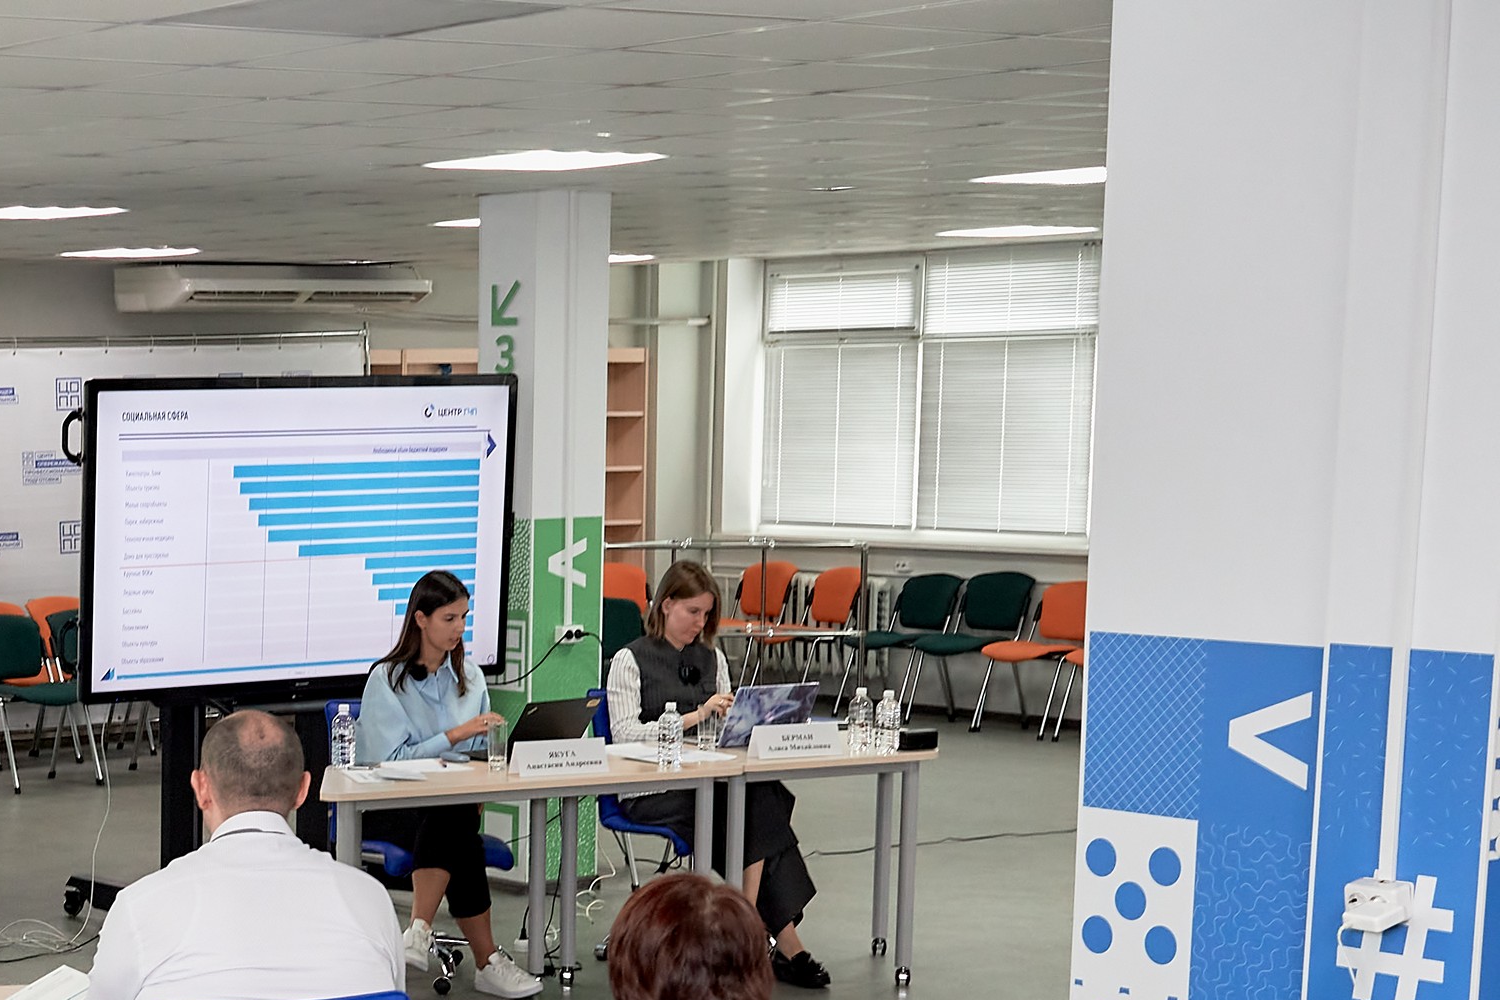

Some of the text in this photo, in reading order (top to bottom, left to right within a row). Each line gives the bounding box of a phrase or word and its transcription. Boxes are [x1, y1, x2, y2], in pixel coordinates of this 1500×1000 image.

[121, 410, 189, 423] СОЦИАЛЬНАЯ СФЕРА
[437, 407, 462, 417] ЦЕНТР
